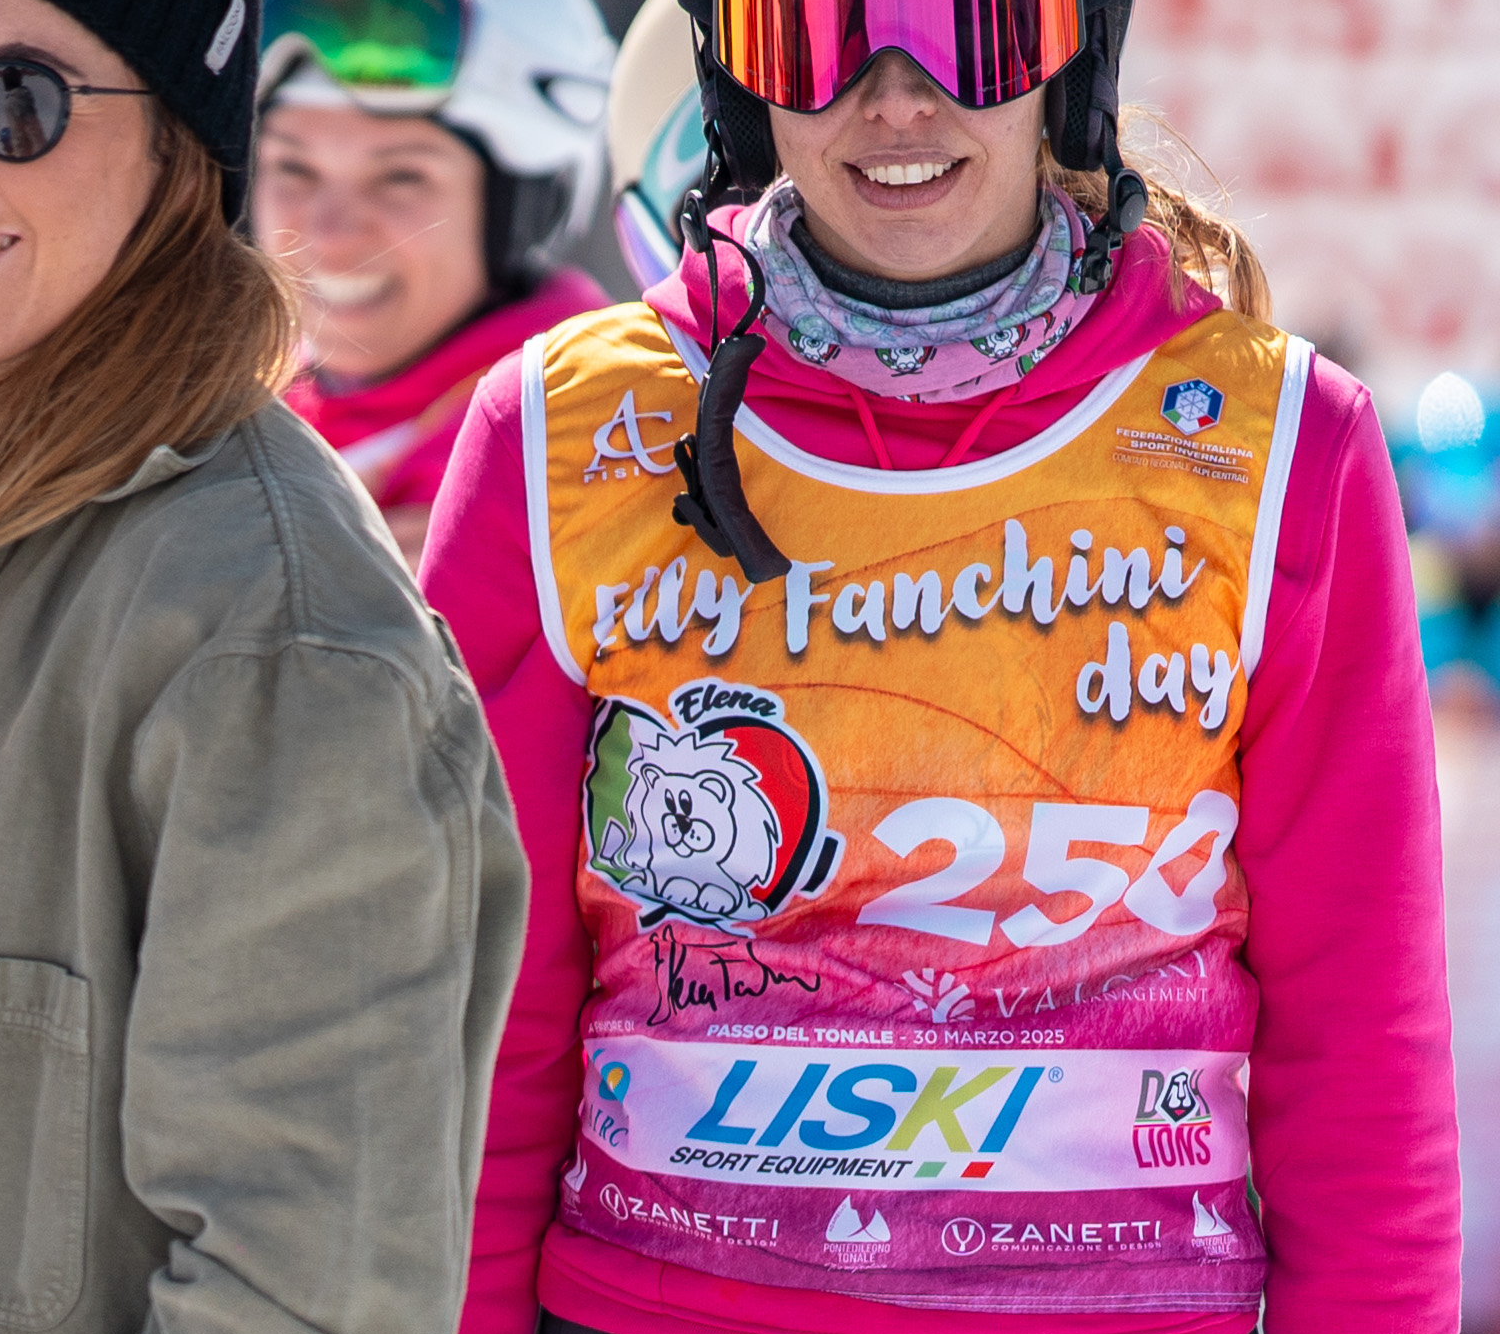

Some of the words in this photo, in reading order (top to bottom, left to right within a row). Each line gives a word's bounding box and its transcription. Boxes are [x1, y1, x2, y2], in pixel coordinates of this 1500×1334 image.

[1116, 427, 1200, 450] FEDERAZIONE
[1201, 444, 1254, 459] ITALIANA
[1130, 439, 1172, 451] SPORT
[1174, 445, 1237, 465] INVERNALI
[1192, 465, 1210, 477] ALPI
[593, 555, 755, 657] Elly
[784, 518, 1205, 654] Fanchini
[1076, 621, 1240, 730] day
[674, 685, 778, 724] Elena
[706, 1023, 769, 1040] PASSO
[772, 1024, 810, 1042] DEL
[813, 1027, 894, 1045] TONALE
[912, 1030, 938, 1045] 30
[944, 1029, 1015, 1045] MARZO
[1019, 1029, 1066, 1045] 2025
[685, 1059, 1046, 1153] LISKI
[668, 1145, 758, 1170] SPORT
[756, 1153, 914, 1178] EQUIPMENT
[1132, 1124, 1212, 1169] LIONS
[627, 1196, 779, 1239] ZANETTI
[633, 1214, 713, 1242] COMUNICAZIONE
[727, 1237, 778, 1248] DESIGN
[990, 1220, 1161, 1244] ZANETTI
[823, 1242, 892, 1254] PONTEDILEGNO
[837, 1252, 876, 1263] TONALE
[991, 1243, 1103, 1253] COMUNICAZIONE
[1120, 1241, 1163, 1252] DESIGN
